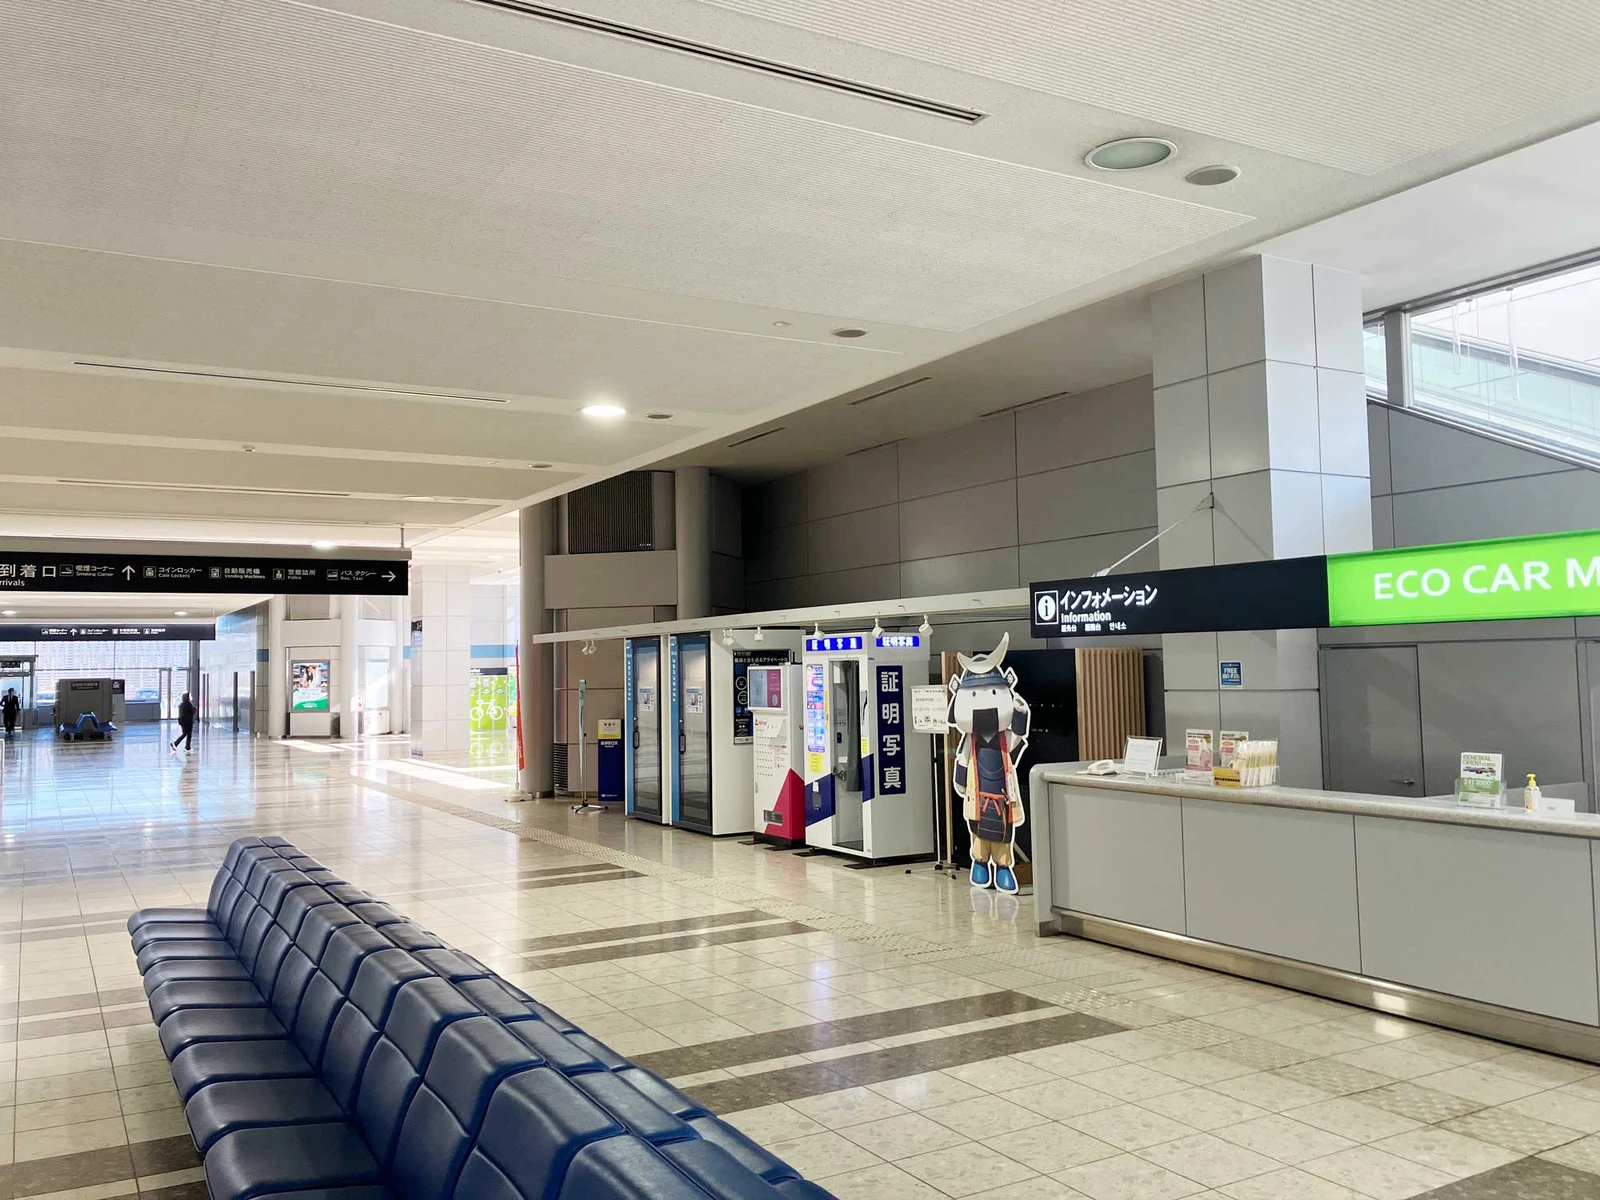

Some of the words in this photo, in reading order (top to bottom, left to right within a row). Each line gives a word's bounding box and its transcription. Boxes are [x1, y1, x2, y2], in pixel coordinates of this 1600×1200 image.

[0, 564, 56, 578] 到着口
[1373, 568, 1451, 600] ECO
[1462, 560, 1552, 594] CAR
[1060, 584, 1158, 611] インフォメーション
[1061, 610, 1112, 623] Information
[880, 671, 902, 789] 証明写真
[1463, 754, 1492, 762] RENEWAL
